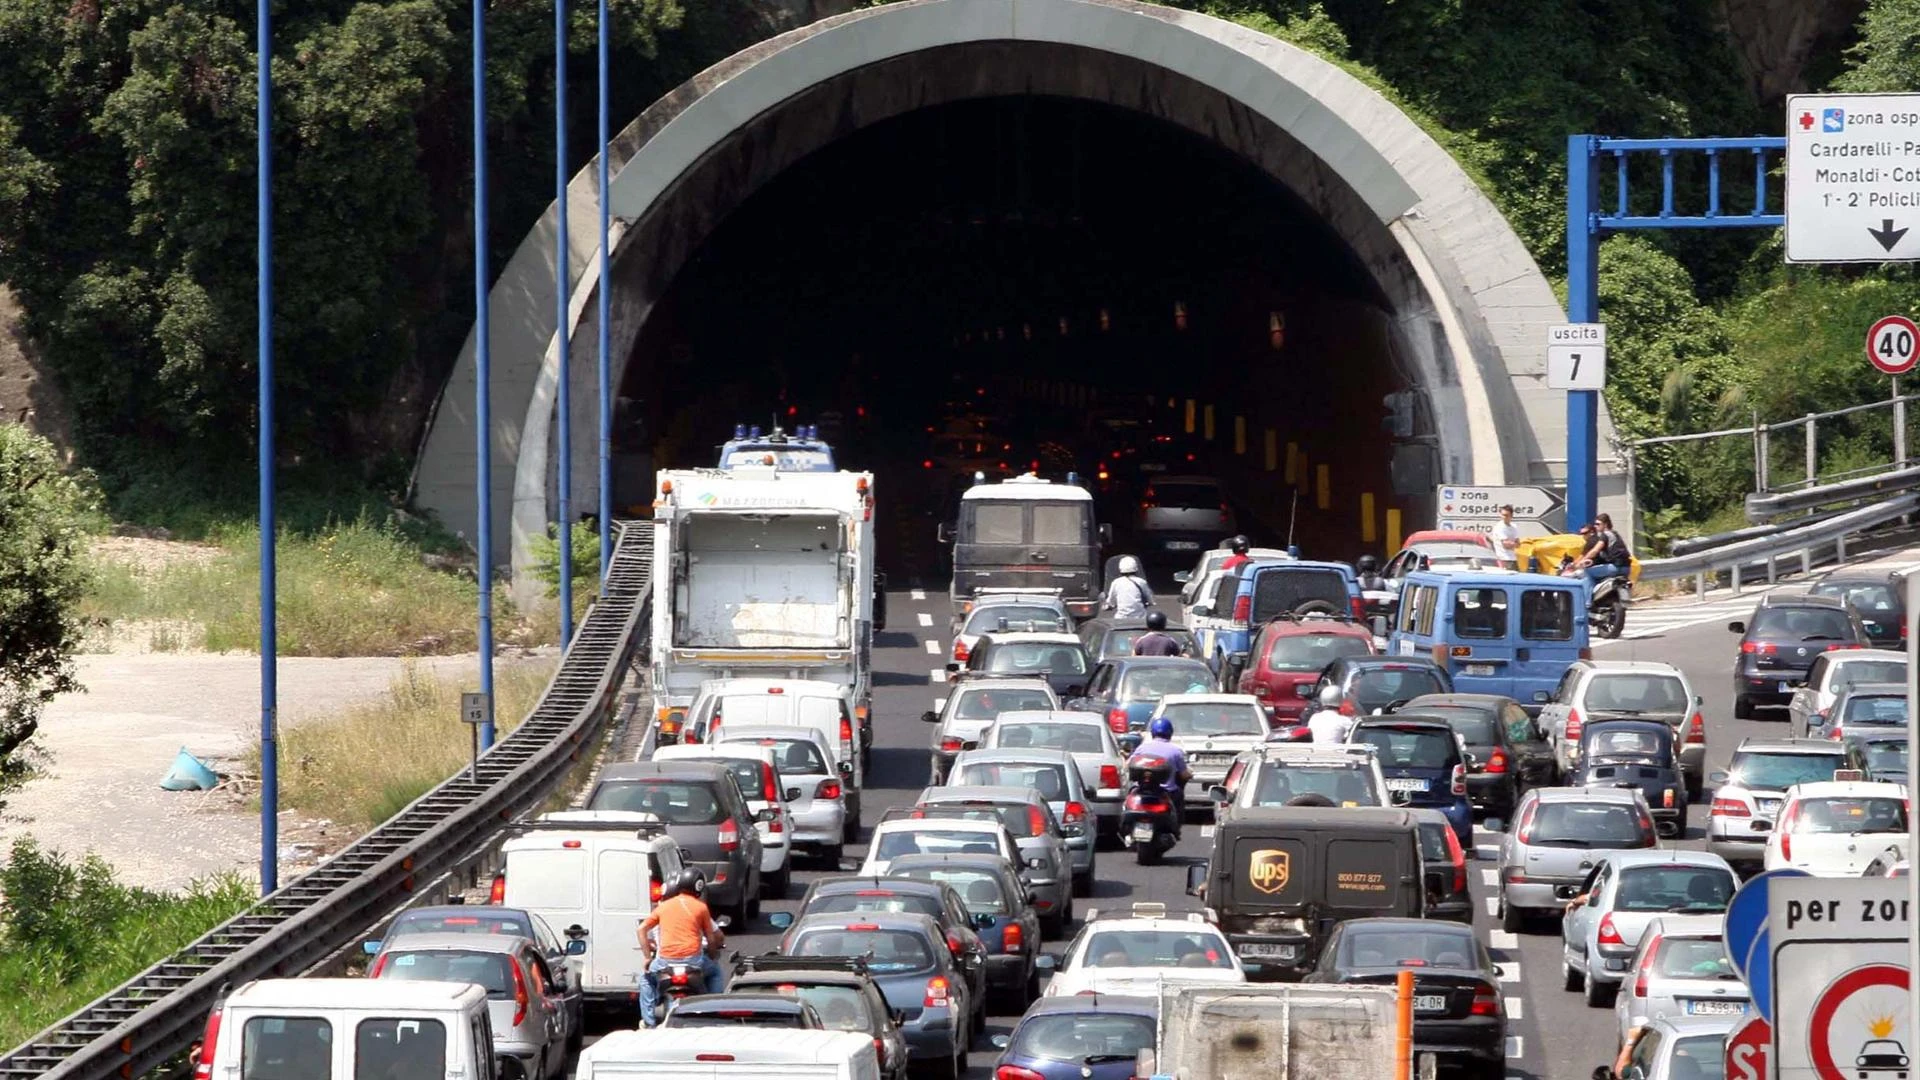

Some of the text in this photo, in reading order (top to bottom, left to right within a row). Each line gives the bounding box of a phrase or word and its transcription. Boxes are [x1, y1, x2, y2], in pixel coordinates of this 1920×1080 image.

[1848, 113, 1920, 127] zona osp
[1810, 142, 1891, 157] Cardarelli
[1816, 168, 1880, 183] Monaldi
[1554, 327, 1598, 339] uscita
[1879, 330, 1912, 358] 40
[1570, 354, 1581, 381] 7
[1460, 491, 1489, 500] zona
[1460, 503, 1534, 514] ospedera
[471, 710, 482, 719] 15
[1254, 862, 1286, 887] ups
[1787, 899, 1840, 930] per
